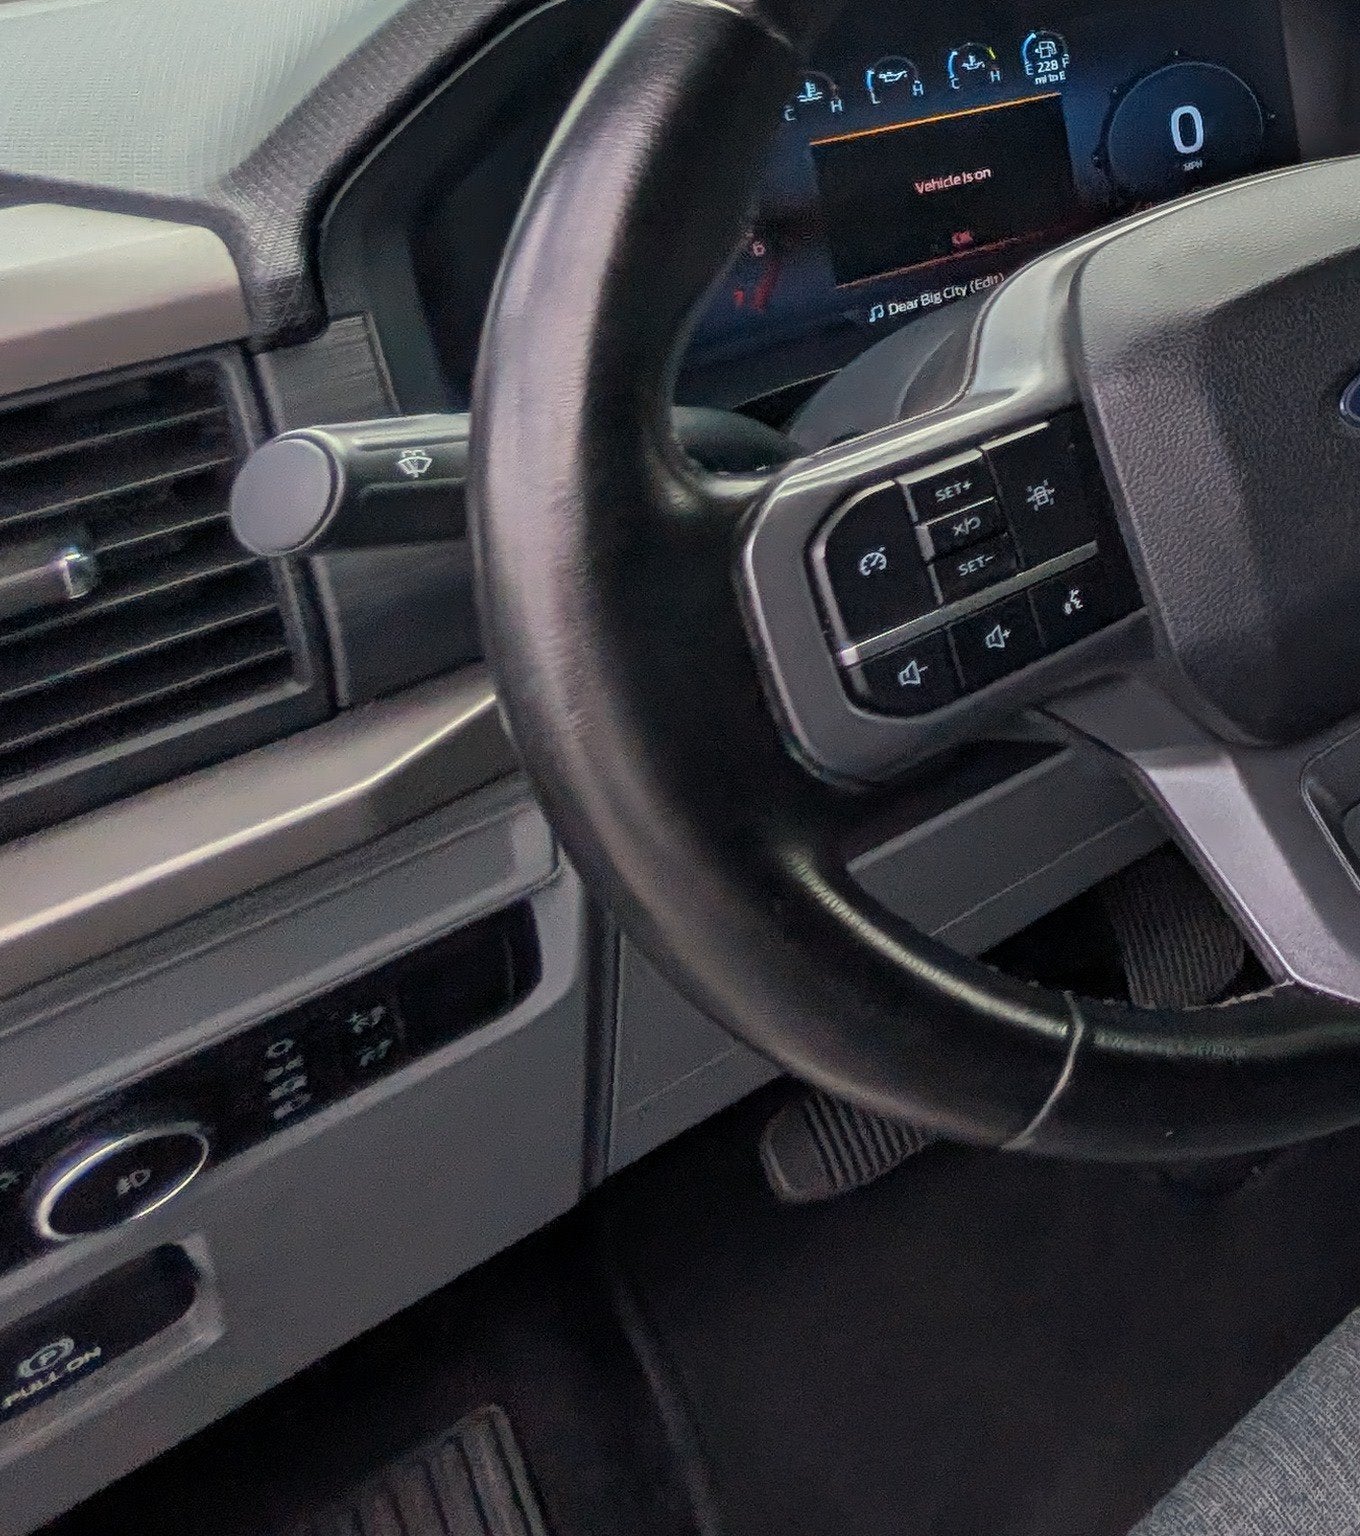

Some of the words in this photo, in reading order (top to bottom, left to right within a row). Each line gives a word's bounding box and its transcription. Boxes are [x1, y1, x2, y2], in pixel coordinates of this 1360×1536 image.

[1037, 60, 1059, 74] 228
[1171, 105, 1204, 154] 0
[914, 175, 961, 195] Vehicle
[974, 167, 992, 180] on
[888, 298, 919, 316] Dear
[920, 290, 943, 307] Big
[943, 283, 968, 298] City
[66, 1347, 101, 1372] ON
